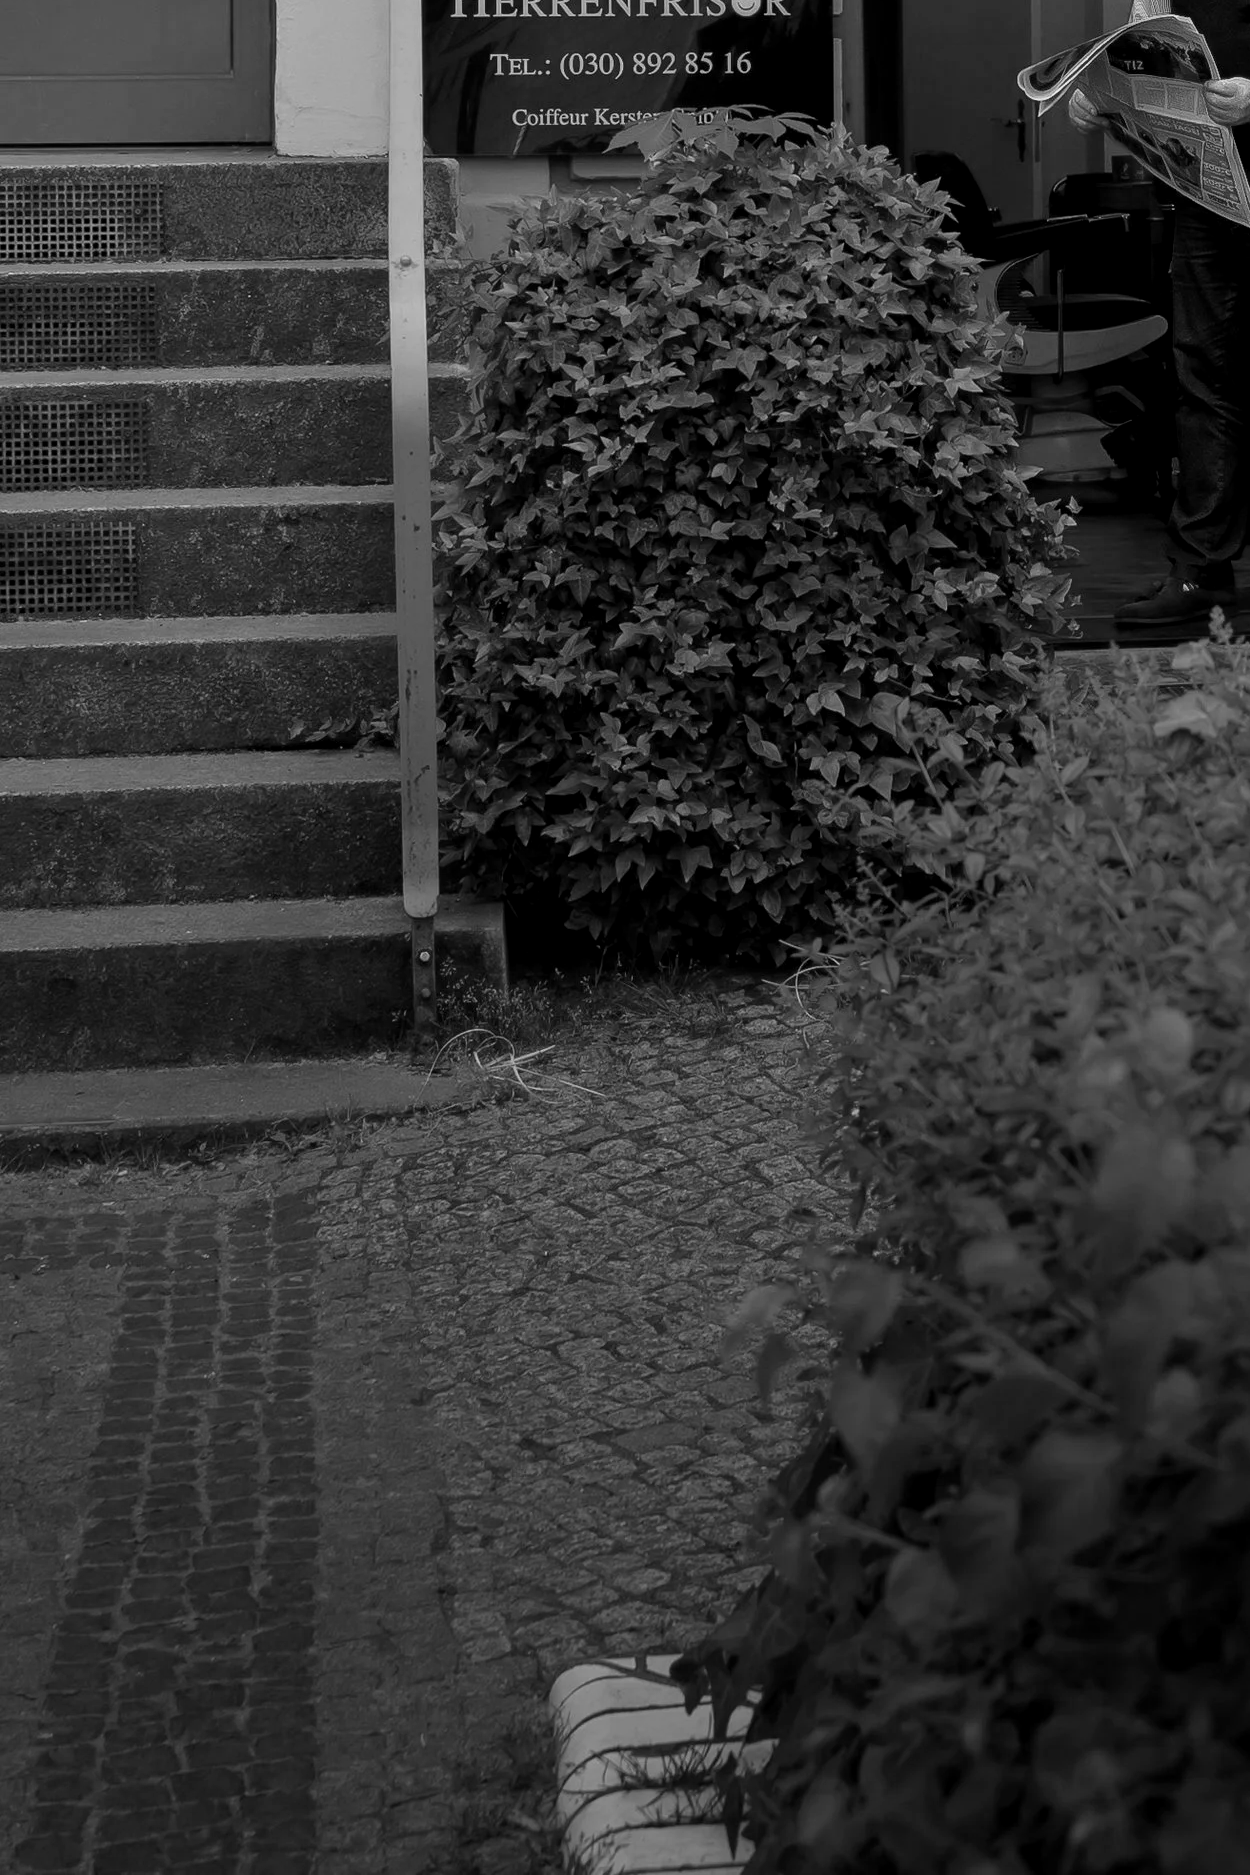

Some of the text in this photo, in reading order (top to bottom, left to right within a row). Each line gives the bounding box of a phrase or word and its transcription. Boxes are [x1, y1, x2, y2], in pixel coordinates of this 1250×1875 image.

[559, 53, 625, 81] (030)
[632, 53, 677, 75] 892
[684, 53, 714, 75] 85
[724, 51, 752, 74] 16
[511, 108, 589, 127] Coiffeur
[594, 109, 662, 127] Kerste
